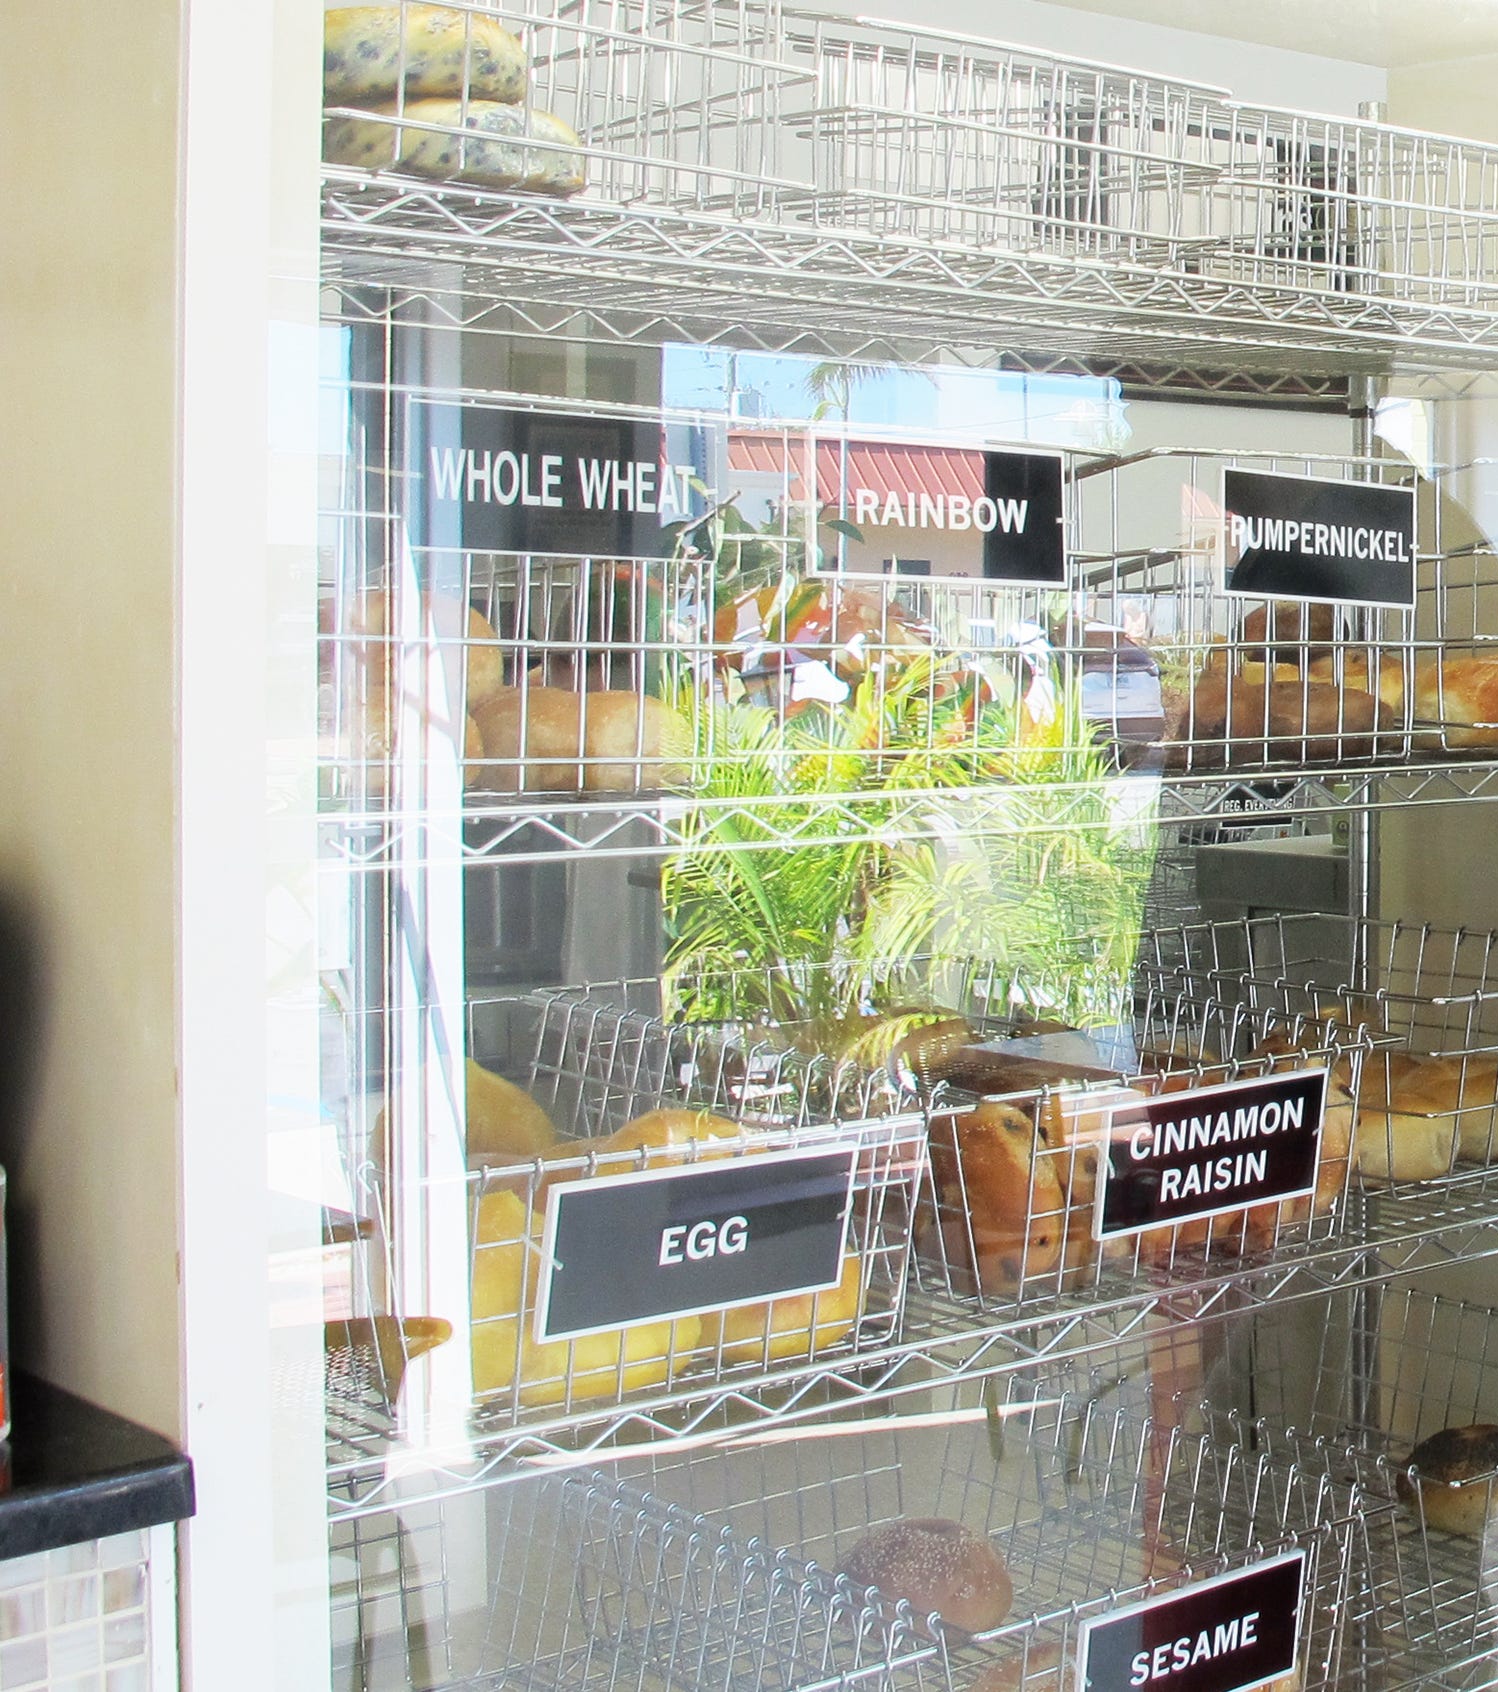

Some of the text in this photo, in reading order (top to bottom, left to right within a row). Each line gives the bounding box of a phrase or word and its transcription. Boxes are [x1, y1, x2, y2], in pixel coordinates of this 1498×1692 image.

[430, 446, 697, 515] WHOLE WHEAT
[855, 489, 1028, 534] RAINBOW
[1230, 514, 1410, 563] PUMPERNICKEL
[1129, 1097, 1305, 1161] CINNAMON
[1159, 1149, 1268, 1204] RAISIN
[659, 1215, 749, 1266] EGG
[1129, 1611, 1258, 1687] SESAME
